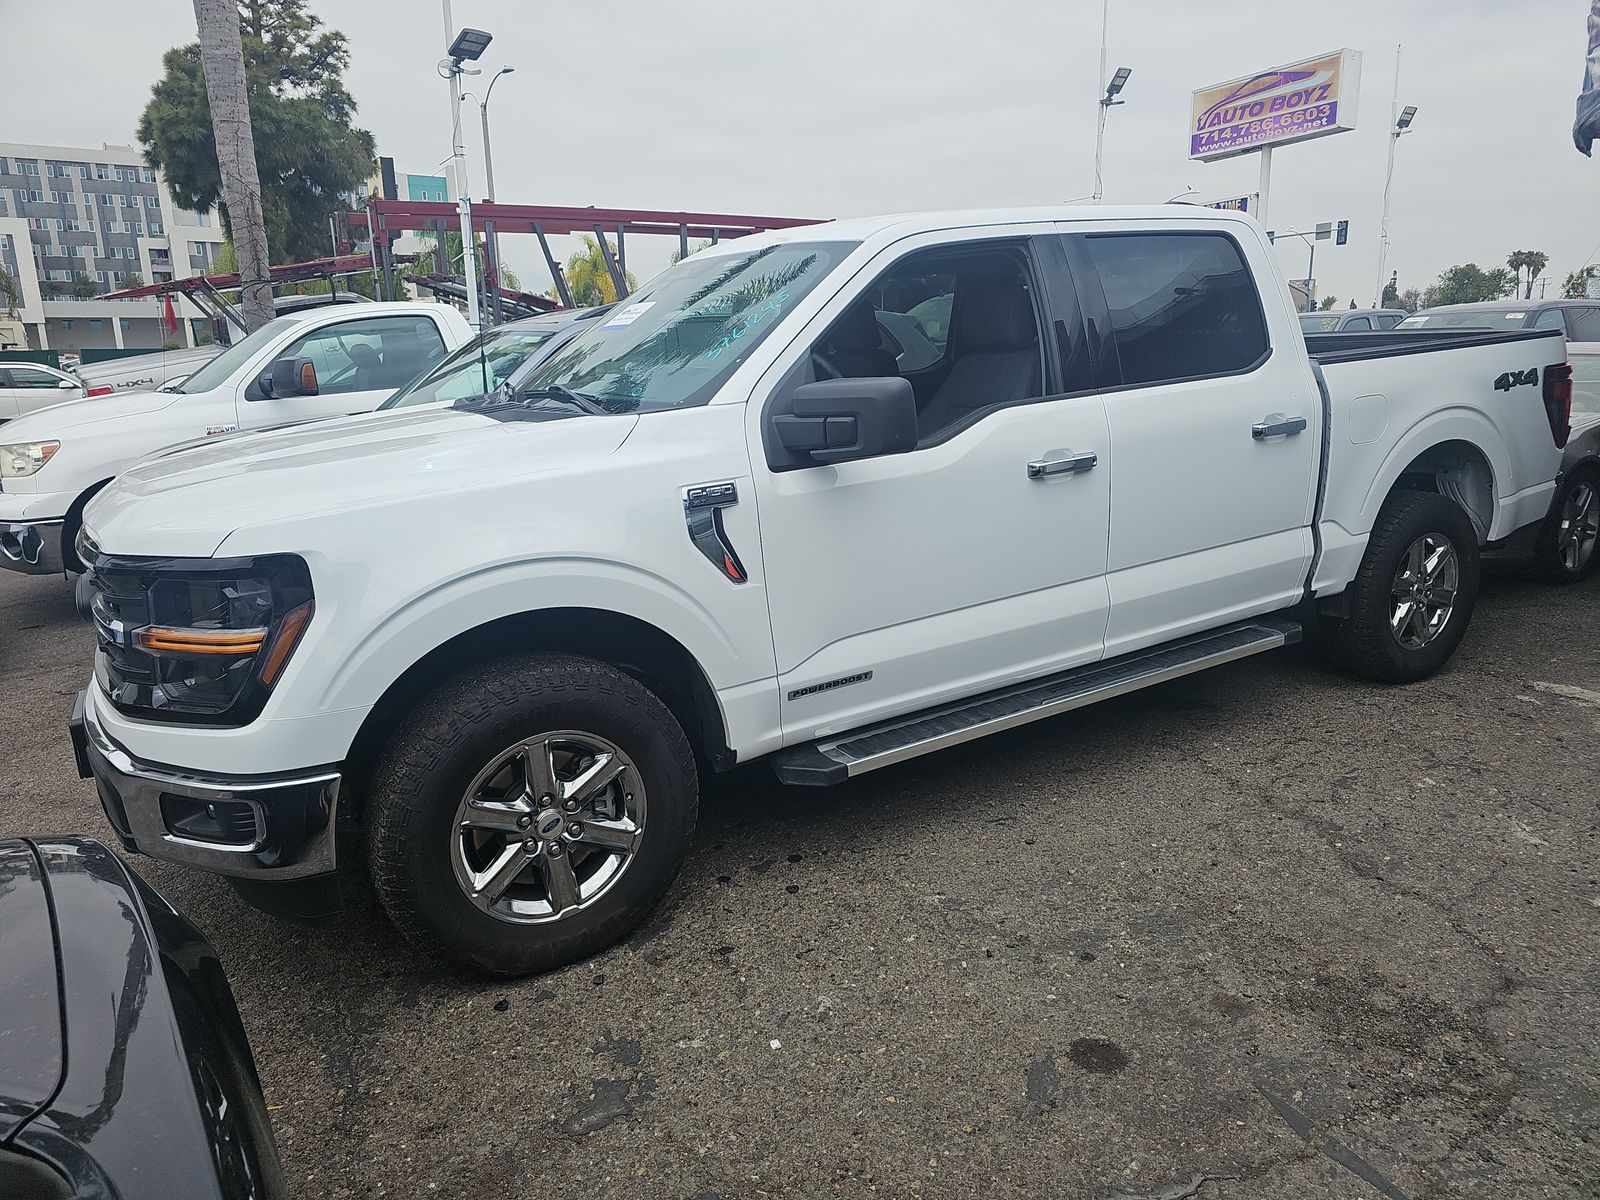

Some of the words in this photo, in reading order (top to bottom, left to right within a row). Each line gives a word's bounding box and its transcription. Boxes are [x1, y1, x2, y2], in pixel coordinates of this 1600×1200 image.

[1207, 102, 1265, 129] AUTO
[1269, 83, 1333, 113] BOYZ
[1199, 117, 1328, 152] www.autoboyz.net
[1200, 104, 1330, 144] 714.786.6603
[689, 484, 734, 500] F-150
[792, 671, 870, 698] POWERBOOST
